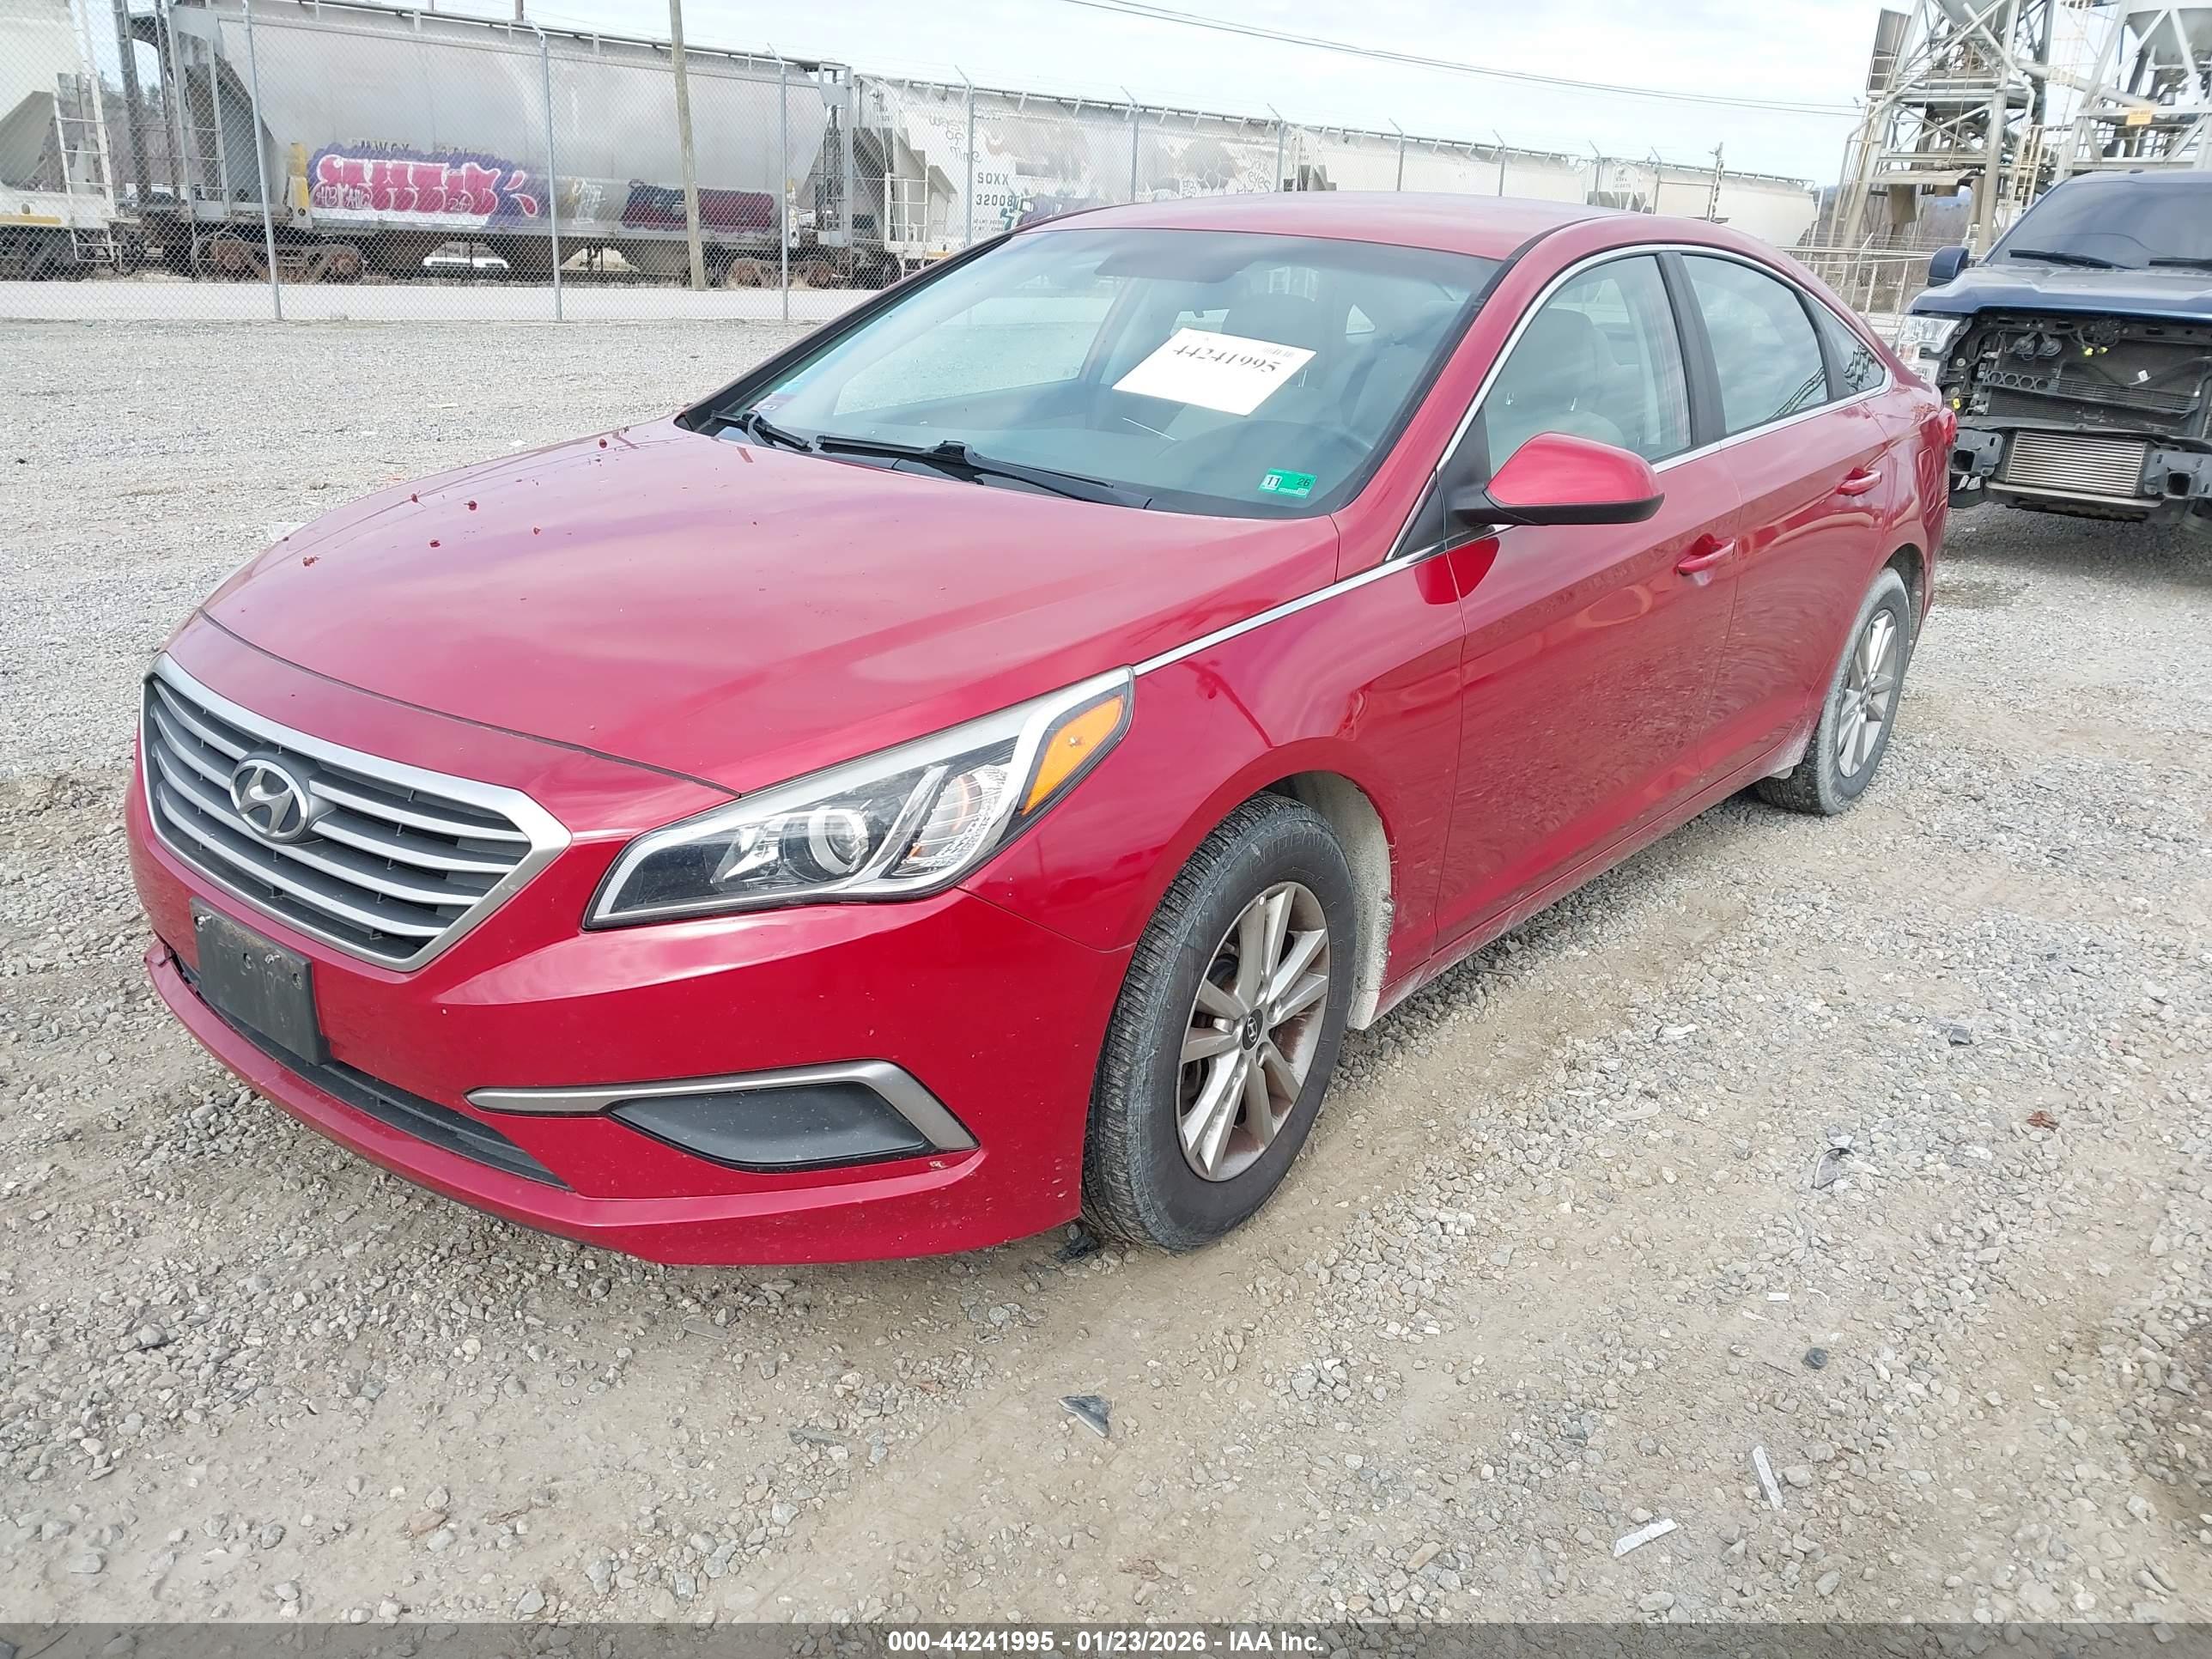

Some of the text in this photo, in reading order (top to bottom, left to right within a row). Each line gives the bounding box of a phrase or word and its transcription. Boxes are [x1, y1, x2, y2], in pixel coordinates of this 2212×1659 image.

[977, 172, 1009, 185] SOXX
[1173, 344, 1282, 373] 44241995
[1267, 477, 1311, 487] 11 26
